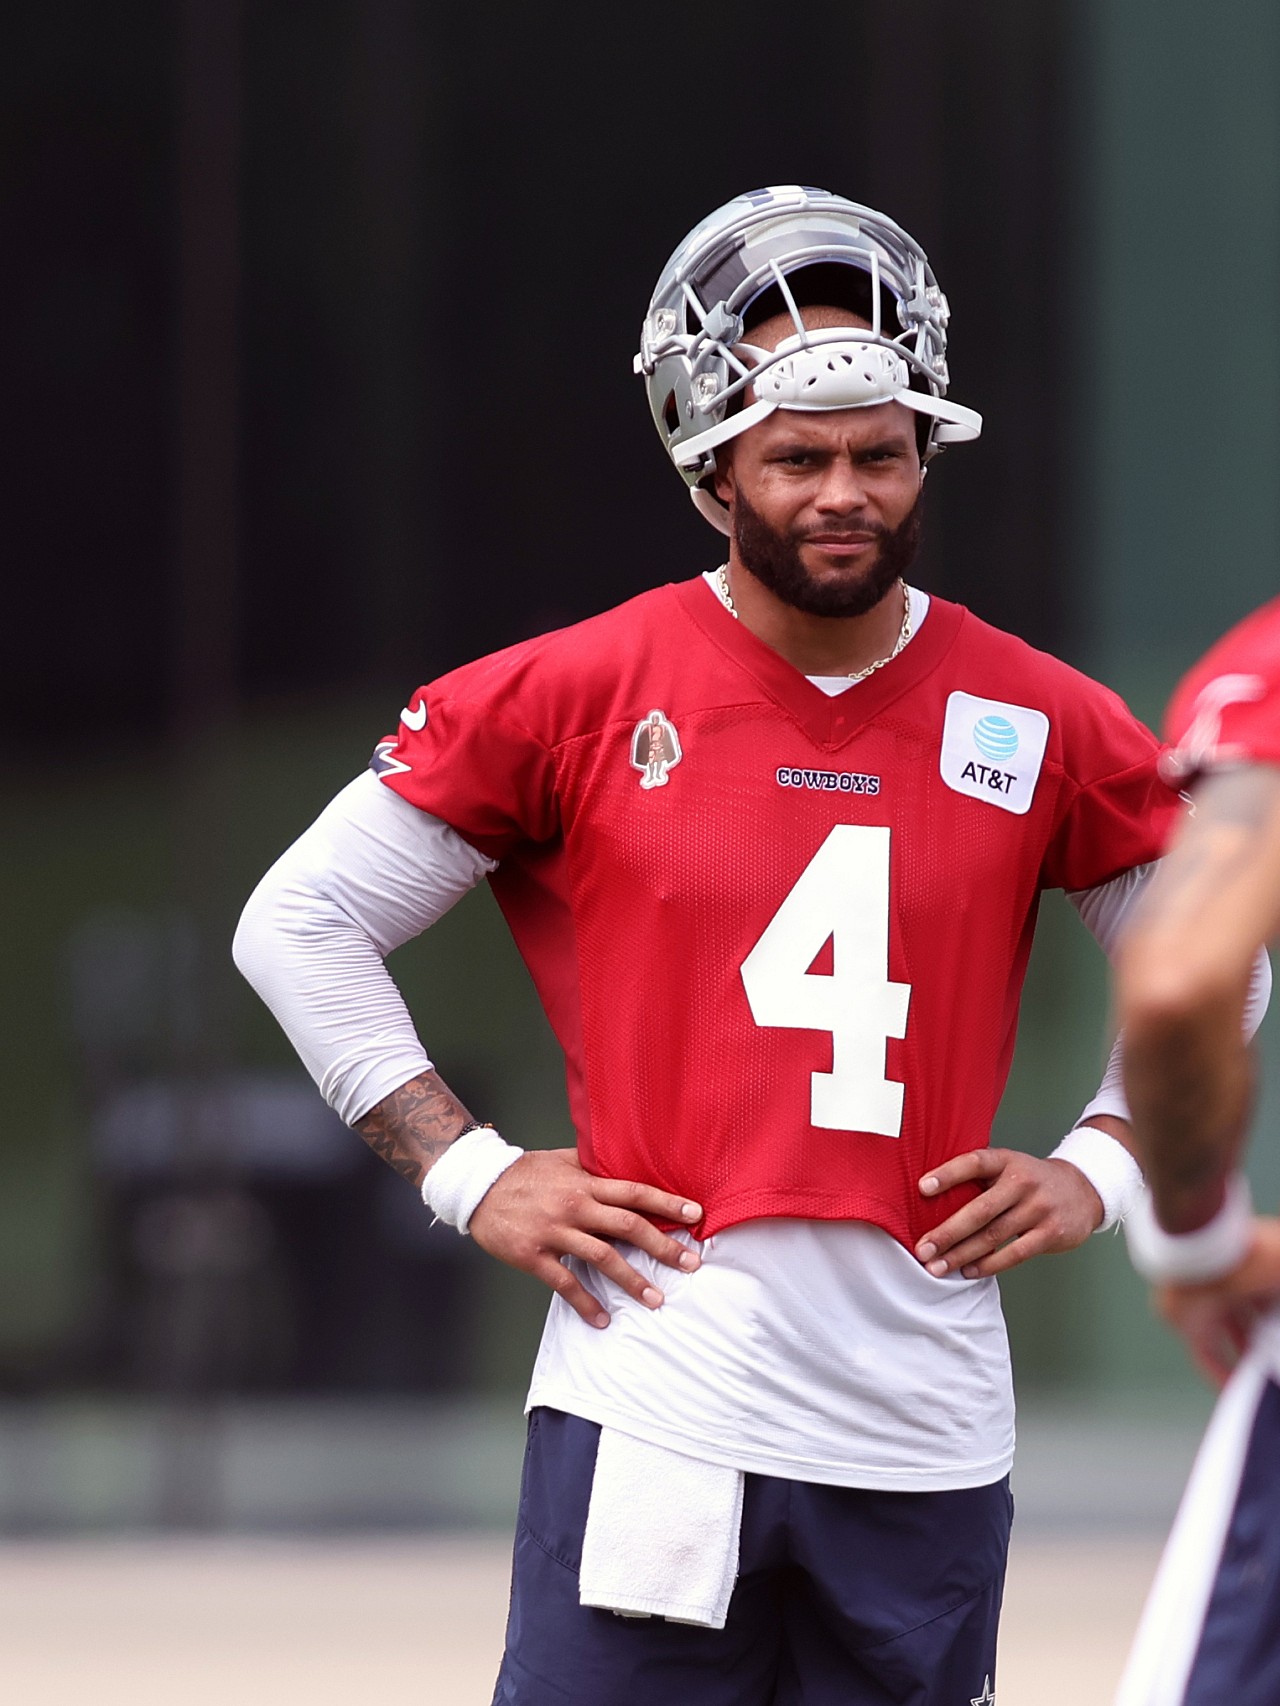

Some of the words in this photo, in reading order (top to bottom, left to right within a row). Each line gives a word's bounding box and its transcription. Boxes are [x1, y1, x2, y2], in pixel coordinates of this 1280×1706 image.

[777, 768, 880, 795] COWBOYS
[960, 761, 1019, 795] AT&T
[739, 823, 912, 1139] 4
